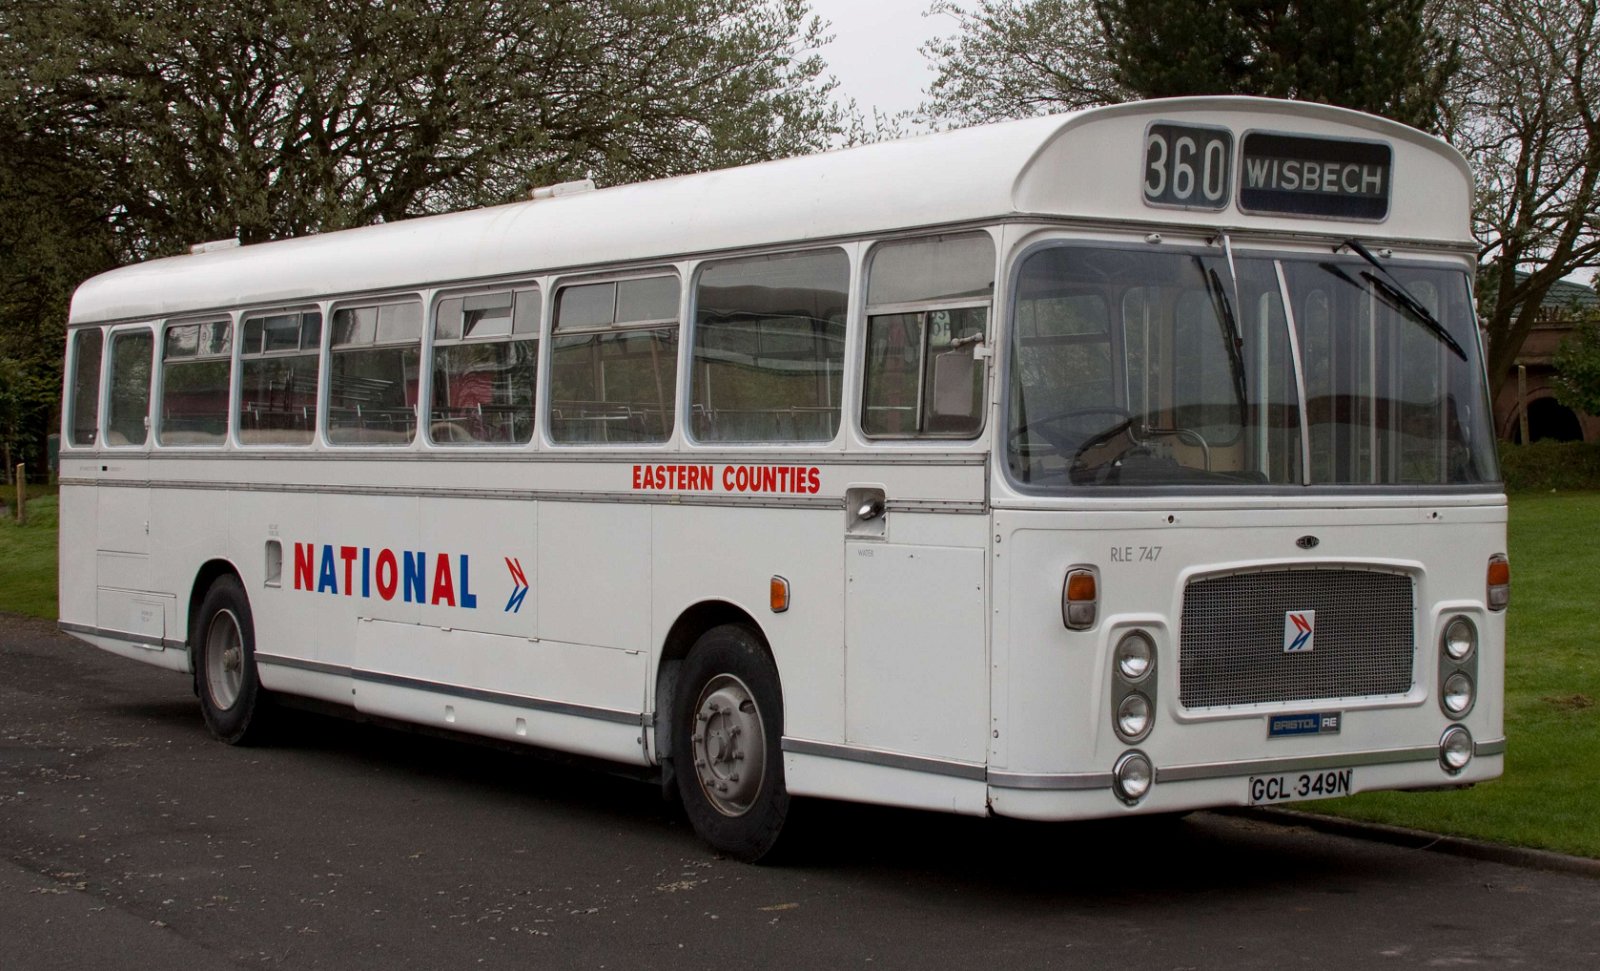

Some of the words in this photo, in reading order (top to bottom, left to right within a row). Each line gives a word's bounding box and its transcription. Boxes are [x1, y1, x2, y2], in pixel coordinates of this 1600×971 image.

[1144, 133, 1225, 201] 360
[1246, 158, 1383, 195] WISBECH
[632, 465, 714, 491] EASTERN
[722, 465, 821, 495] COUNTIES
[1110, 546, 1133, 562] RLE
[1138, 546, 1163, 562] 747
[293, 542, 477, 609] NATIONAL
[1273, 719, 1317, 731] BRISTOL
[1322, 717, 1337, 727] RE
[1252, 776, 1291, 801] GCL
[1298, 770, 1351, 797] 349N
